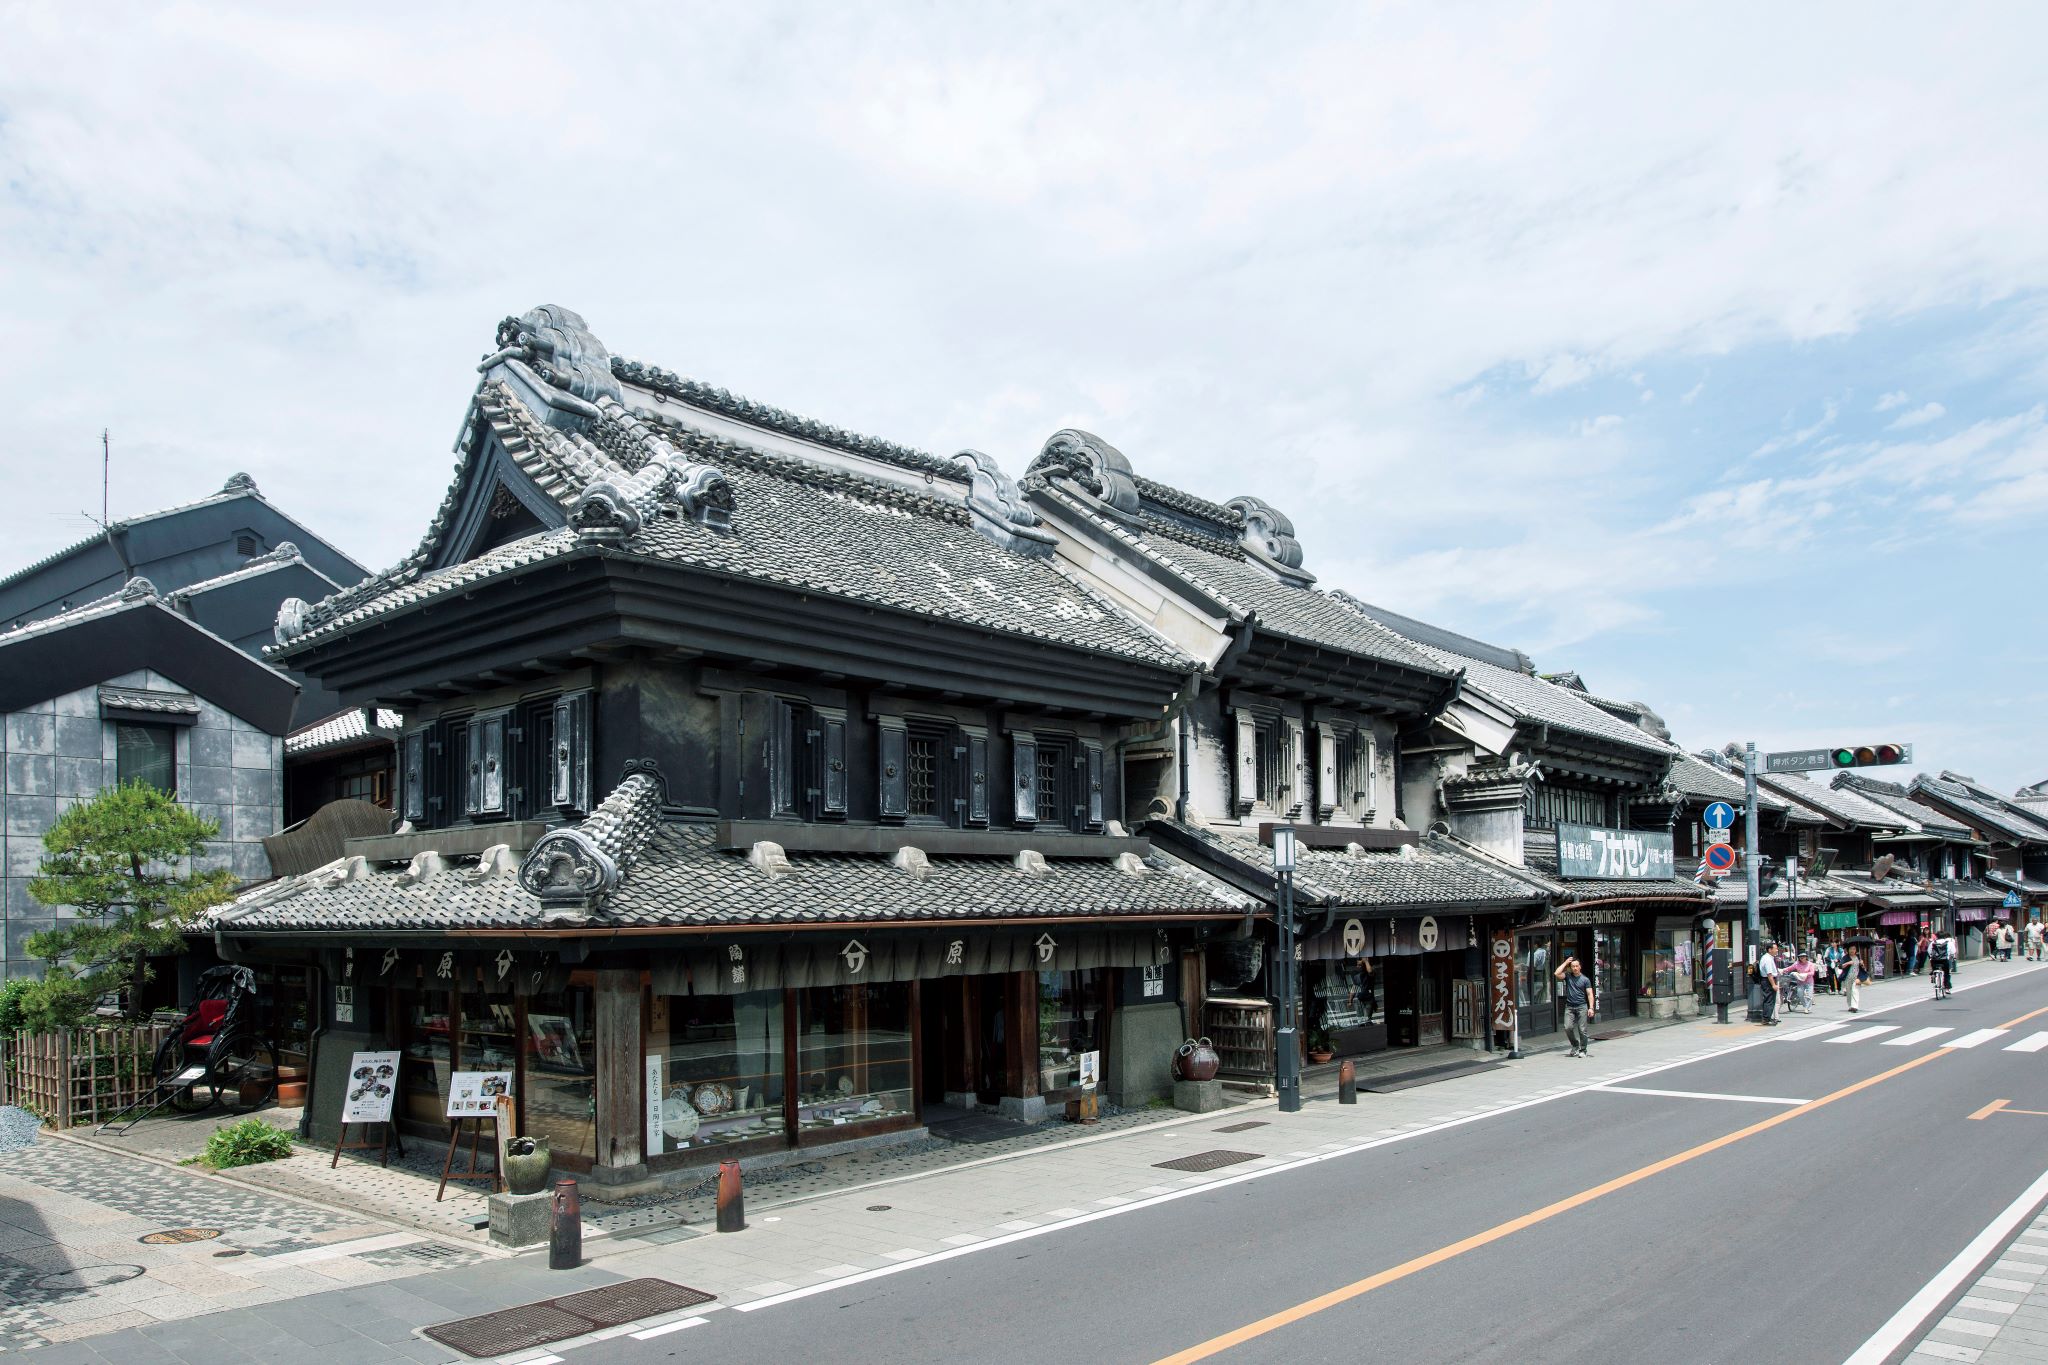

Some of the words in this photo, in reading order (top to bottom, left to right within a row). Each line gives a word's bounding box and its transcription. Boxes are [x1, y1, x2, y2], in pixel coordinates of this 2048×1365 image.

[1773, 754, 1825, 766] 押ボタン信号
[437, 952, 453, 979] 原
[946, 940, 964, 965] 原
[1494, 961, 1514, 1028] まちかん
